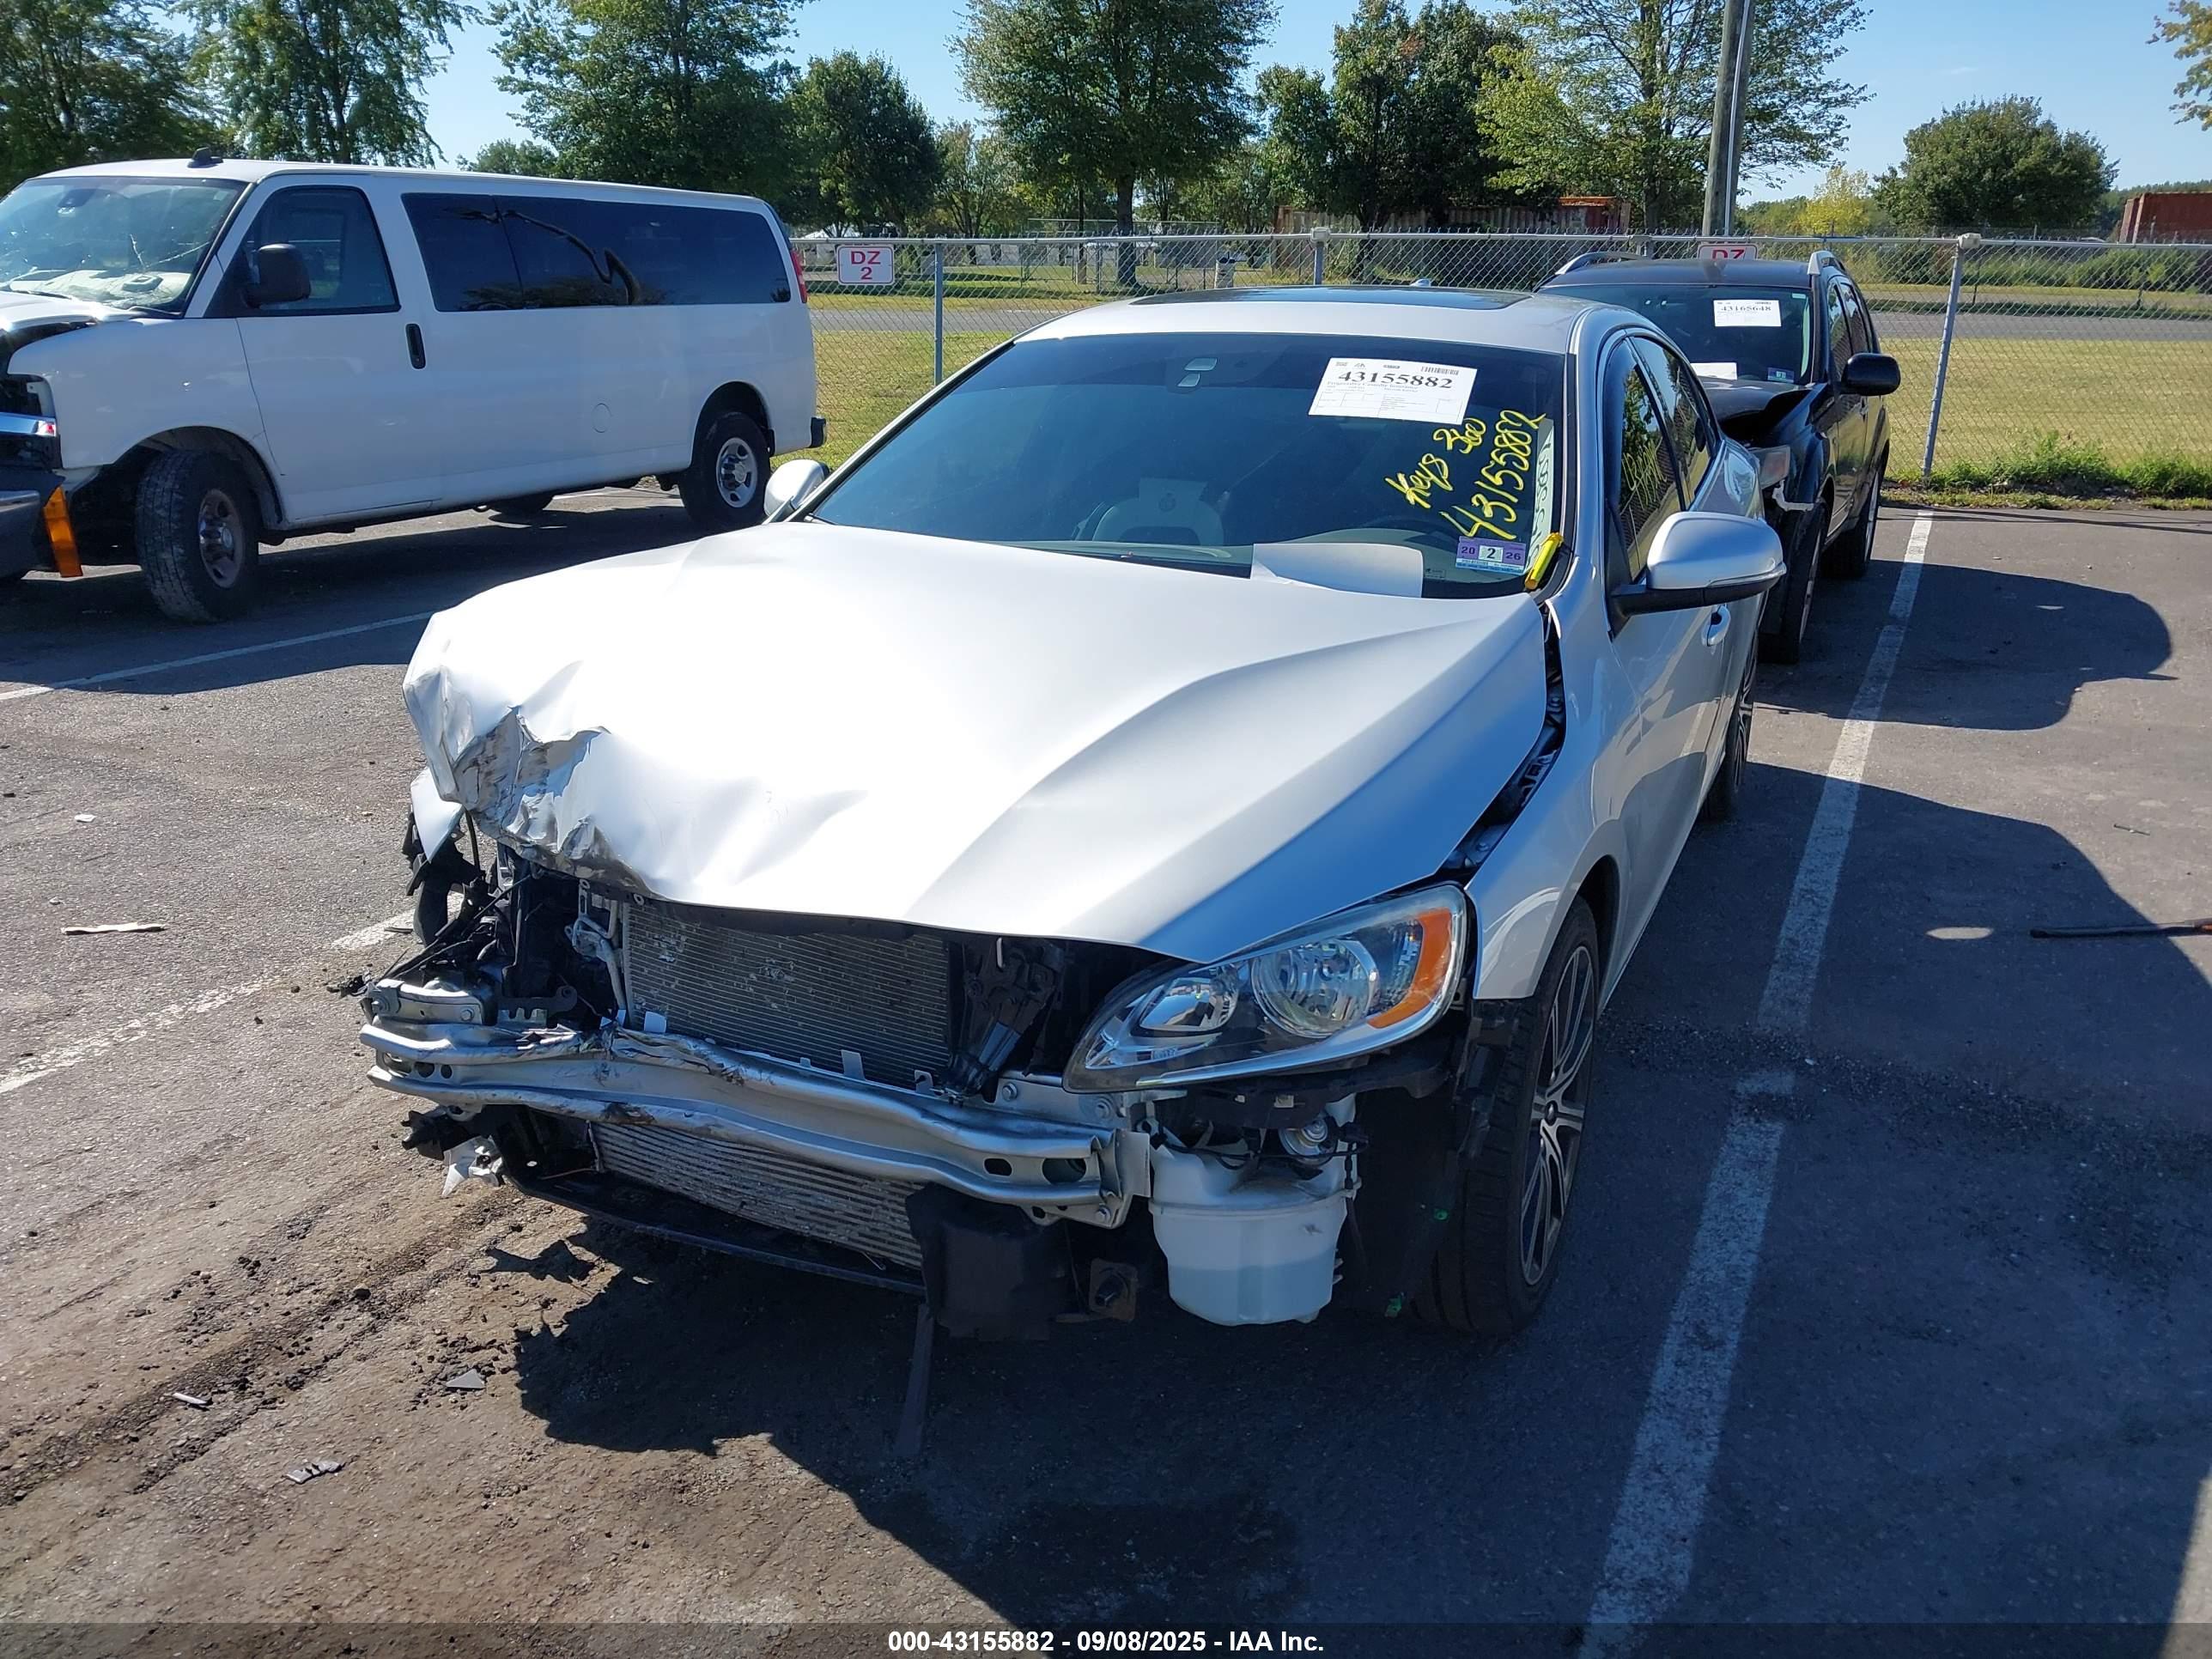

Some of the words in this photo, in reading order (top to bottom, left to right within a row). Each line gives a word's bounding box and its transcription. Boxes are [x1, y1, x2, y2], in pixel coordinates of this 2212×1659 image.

[851, 251, 881, 264] DZ
[860, 266, 873, 280] 2
[1338, 371, 1453, 389] 43155882
[1384, 453, 1453, 509] Keys
[1438, 410, 1547, 540] 43155882
[1462, 546, 1475, 555] 20
[1486, 548, 1496, 559] 2
[1505, 552, 1521, 561] 26
